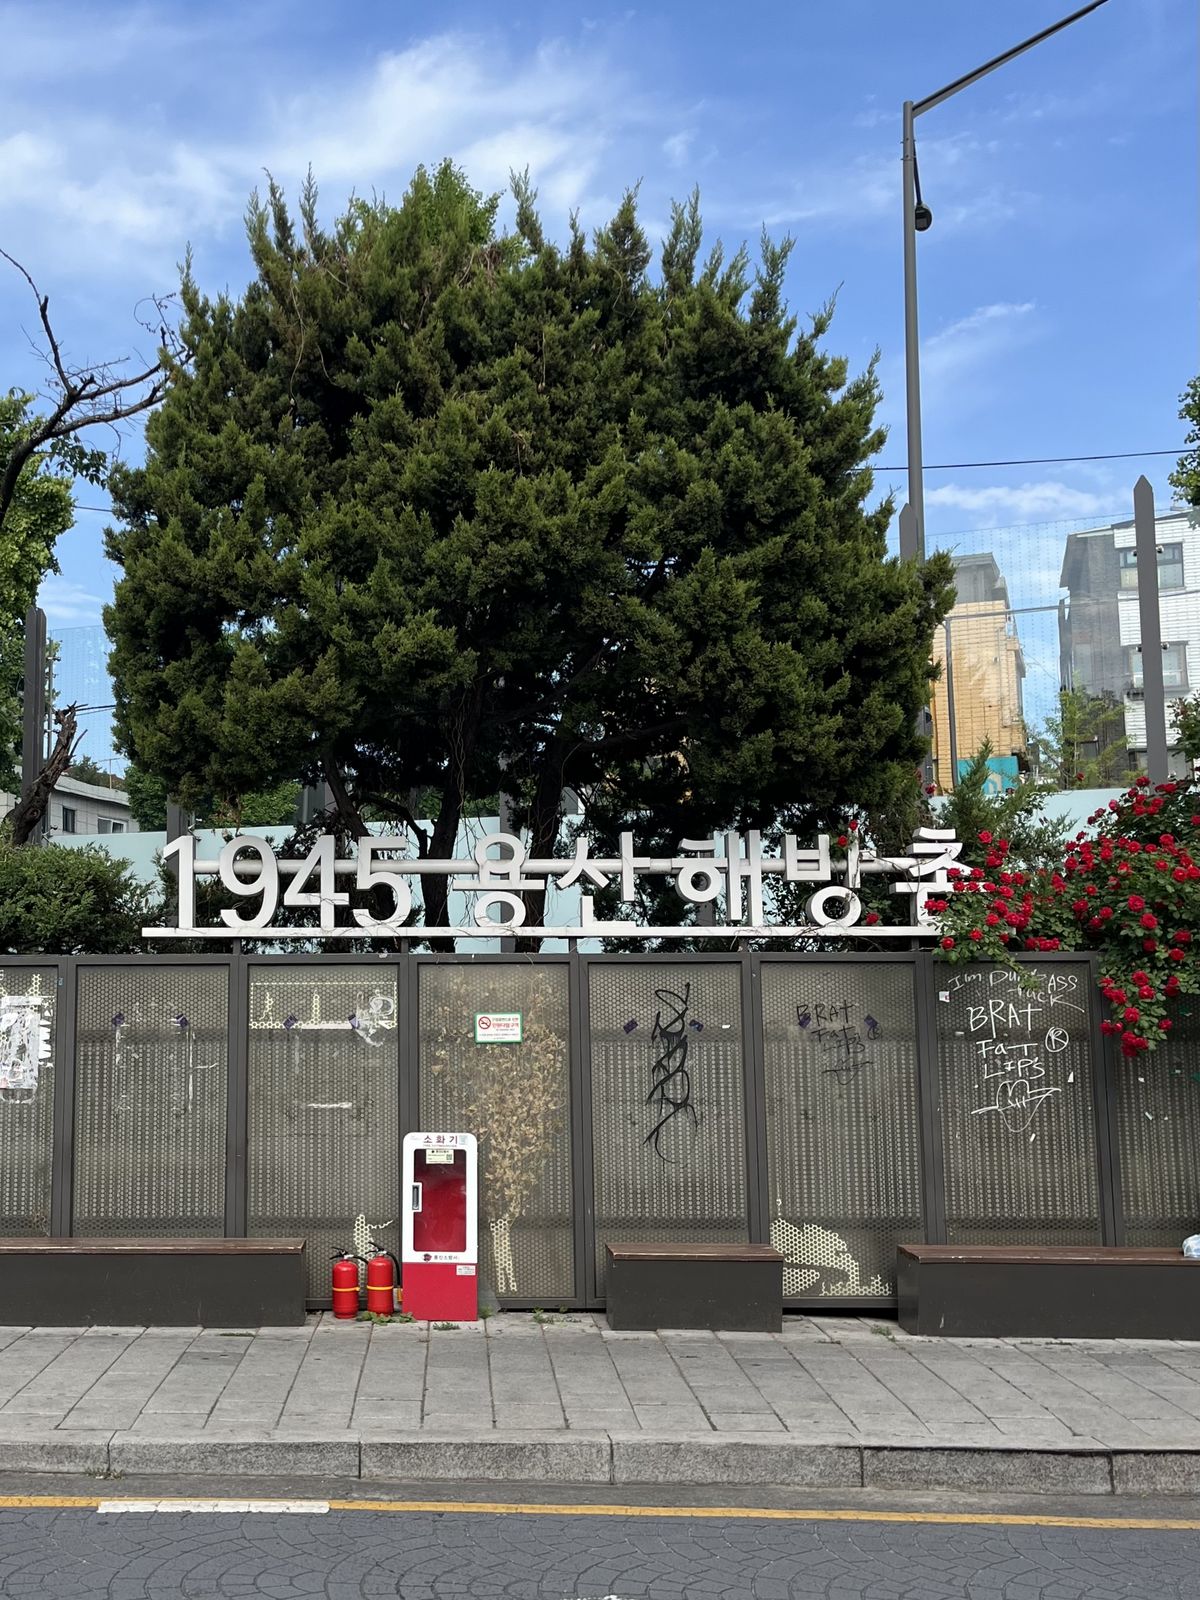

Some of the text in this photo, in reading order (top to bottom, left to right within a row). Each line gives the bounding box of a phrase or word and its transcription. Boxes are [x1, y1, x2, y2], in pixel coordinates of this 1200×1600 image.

[163, 826, 990, 930] 1945 용산해방촌
[423, 1134, 458, 1145] 소화기
